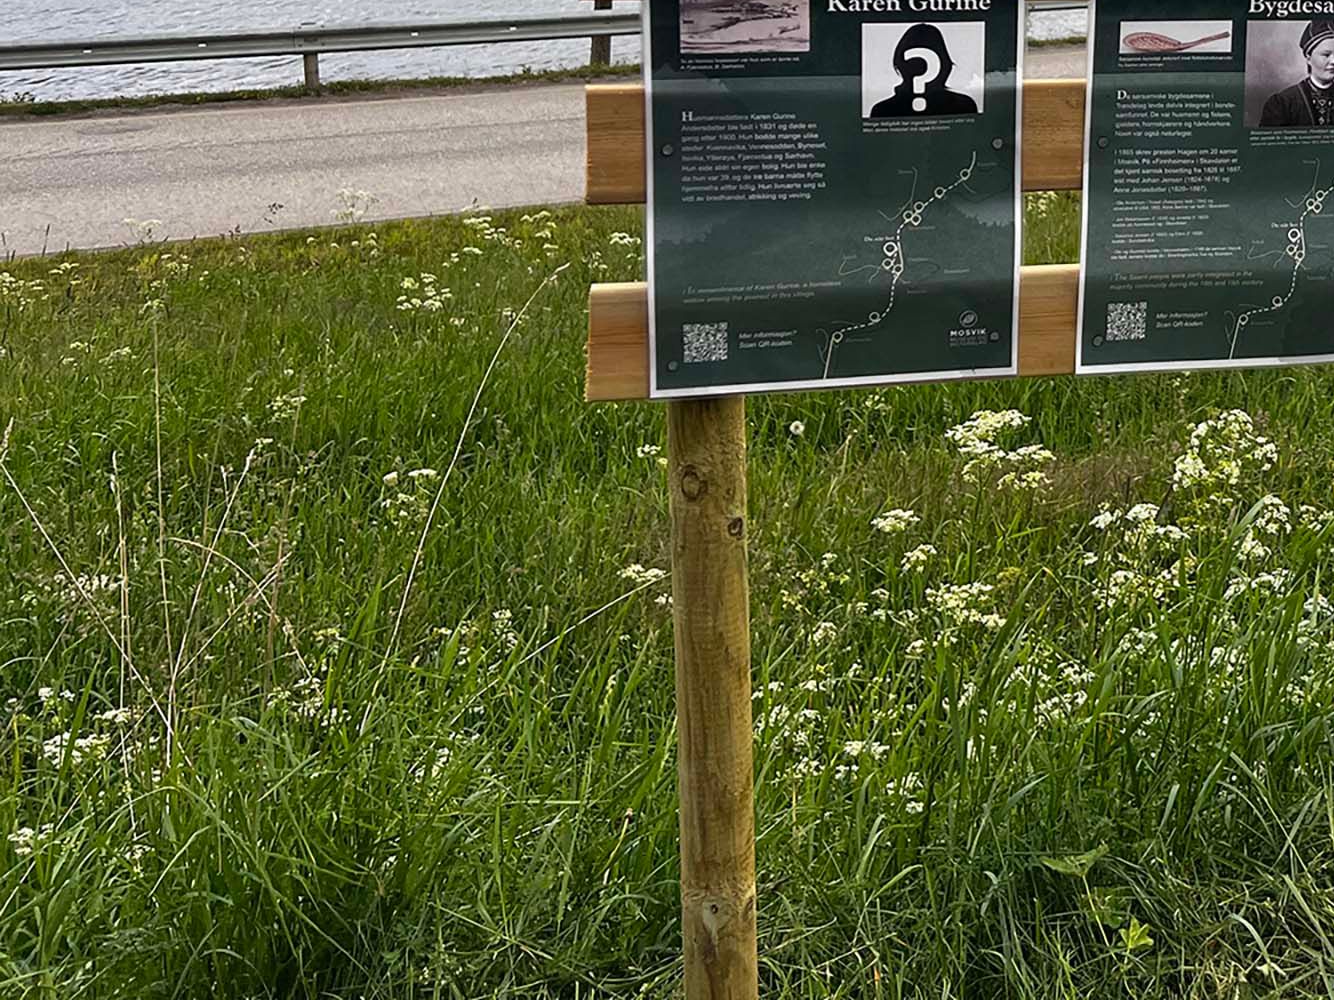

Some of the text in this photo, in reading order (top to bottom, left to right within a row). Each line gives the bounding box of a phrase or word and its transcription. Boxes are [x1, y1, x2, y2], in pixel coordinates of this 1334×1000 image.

[750, 112, 771, 120] Karen
[772, 112, 796, 120] Gurine
[950, 328, 987, 337] MOSVIK
